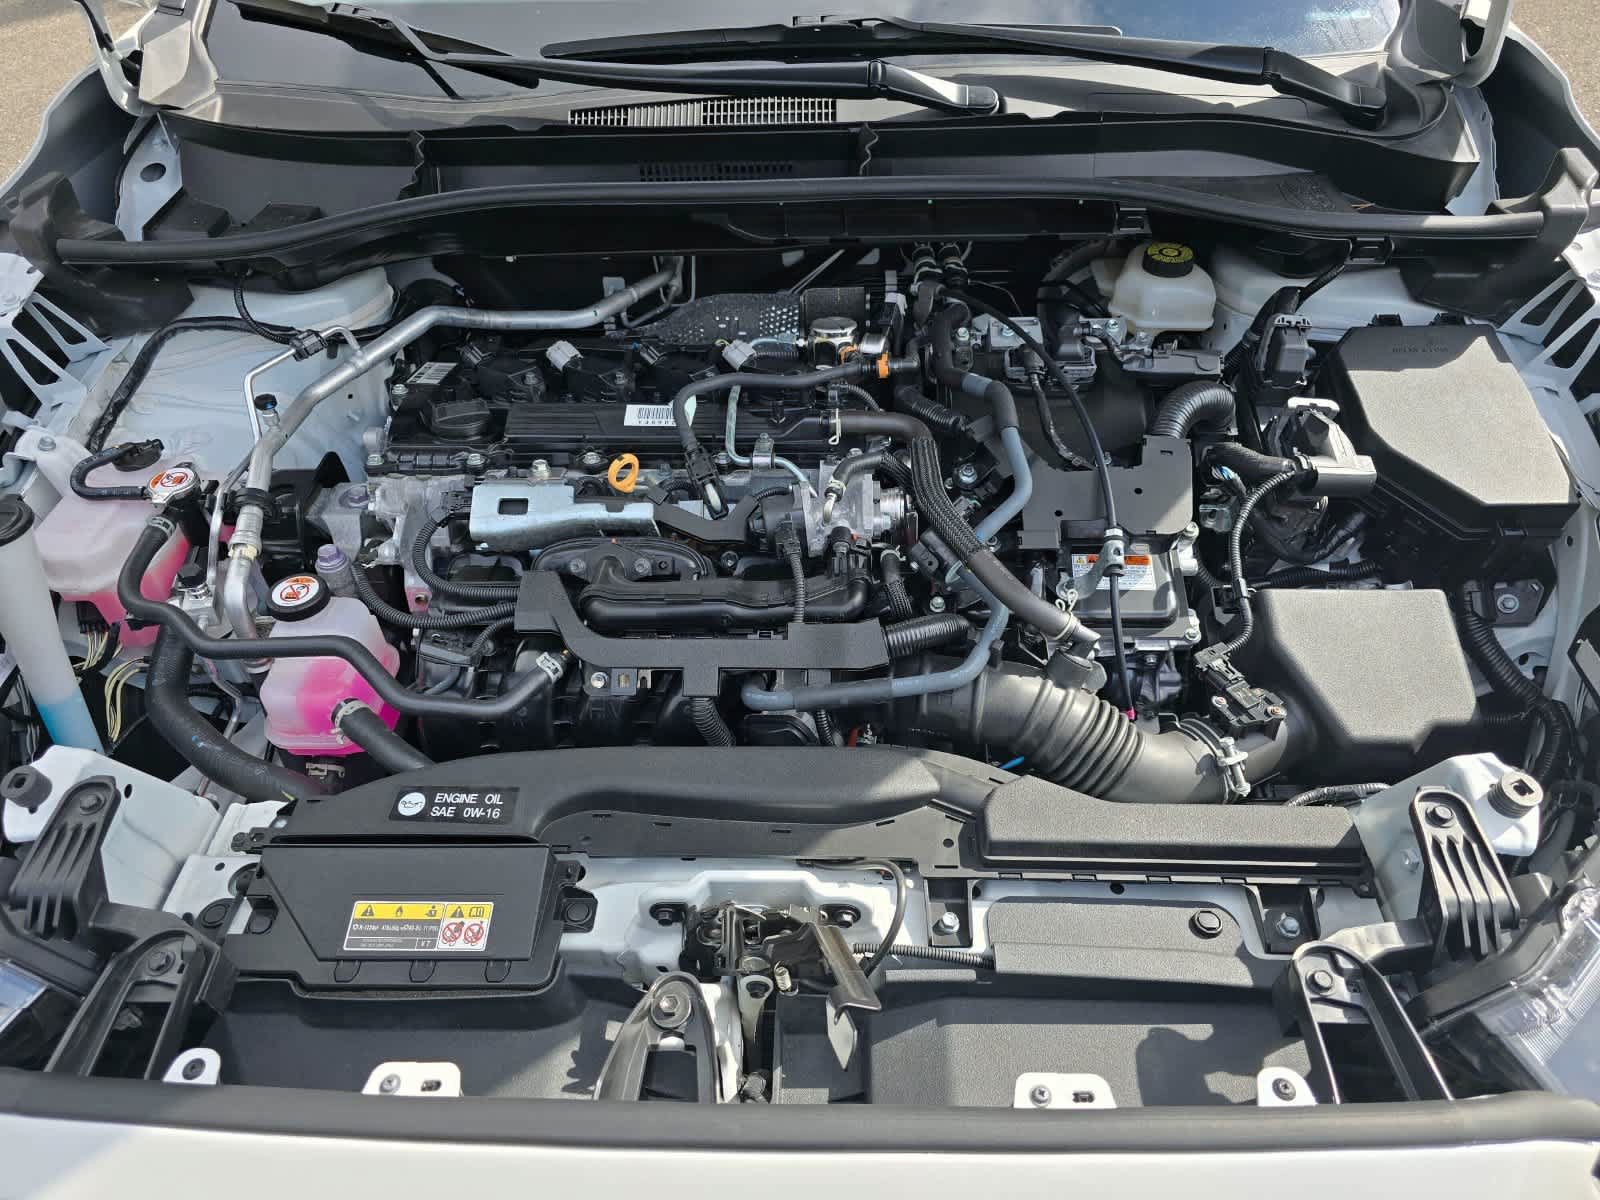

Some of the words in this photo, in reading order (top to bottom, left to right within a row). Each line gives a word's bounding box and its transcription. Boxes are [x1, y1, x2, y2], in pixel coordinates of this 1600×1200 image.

[434, 792, 478, 804] ENGINE
[484, 793, 504, 805] OIL
[430, 806, 456, 817] SAE
[463, 807, 501, 819] 0W-16
